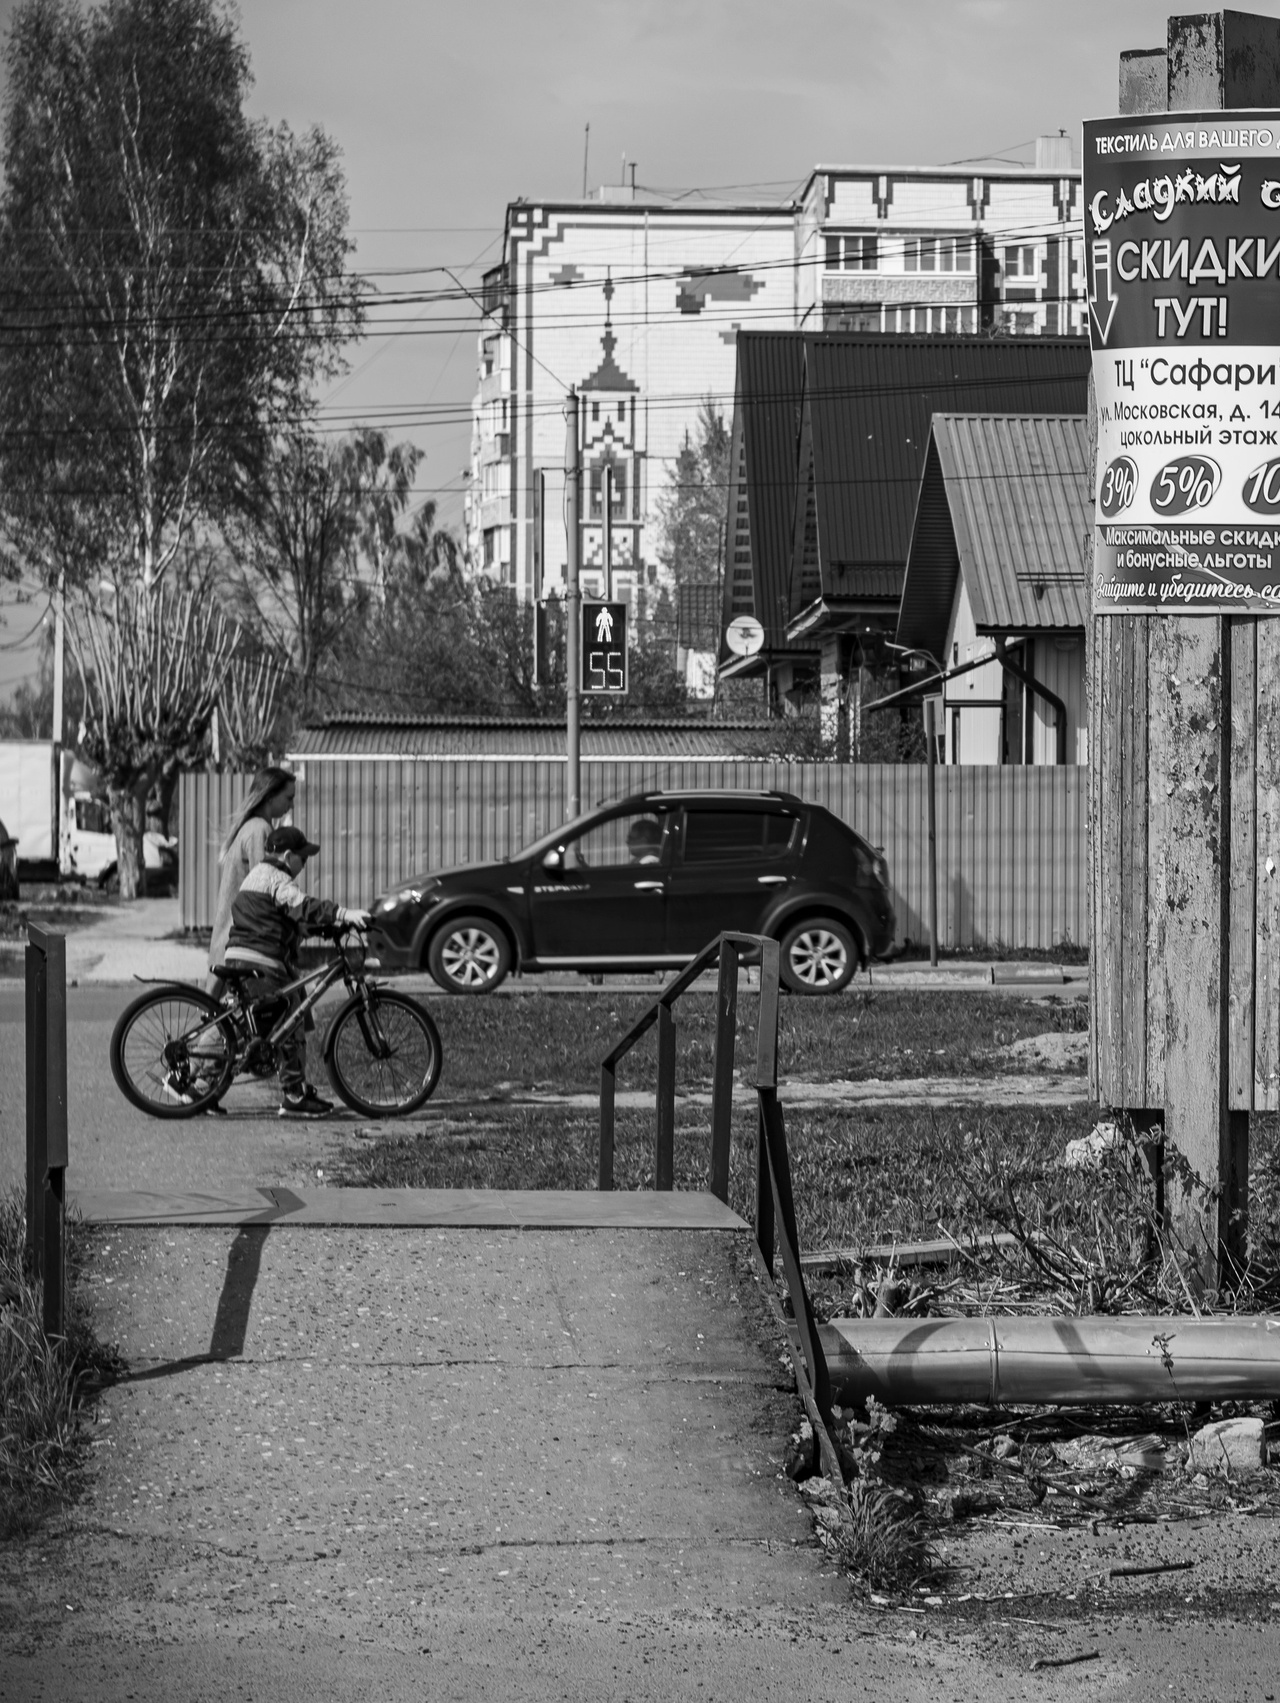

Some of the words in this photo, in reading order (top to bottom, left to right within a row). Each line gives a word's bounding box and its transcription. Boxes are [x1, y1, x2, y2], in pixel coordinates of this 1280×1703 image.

[1096, 133, 1158, 154] ТЕКСТИЛЬ
[1160, 131, 1195, 152] ДЛЯ
[1199, 129, 1273, 148] ВАШЕГО
[1153, 297, 1227, 337] ТУТ!
[1114, 359, 1134, 391] ТЦ
[1100, 406, 1112, 426] ул.
[1114, 401, 1223, 423] Московская,
[1229, 404, 1251, 422] д.
[1120, 425, 1212, 449] цокольный
[1218, 429, 1278, 446] этаж
[1102, 466, 1134, 507] 3%
[1155, 466, 1213, 507] 5%
[1106, 526, 1216, 546] Максимальные
[1116, 552, 1124, 568] и
[1126, 549, 1200, 571] бонусные
[1203, 552, 1272, 569] льготы
[1096, 572, 1146, 603] Зайдите
[1148, 582, 1158, 597] и
[1160, 573, 1254, 603] убедитесь
[589, 651, 623, 689] 55
